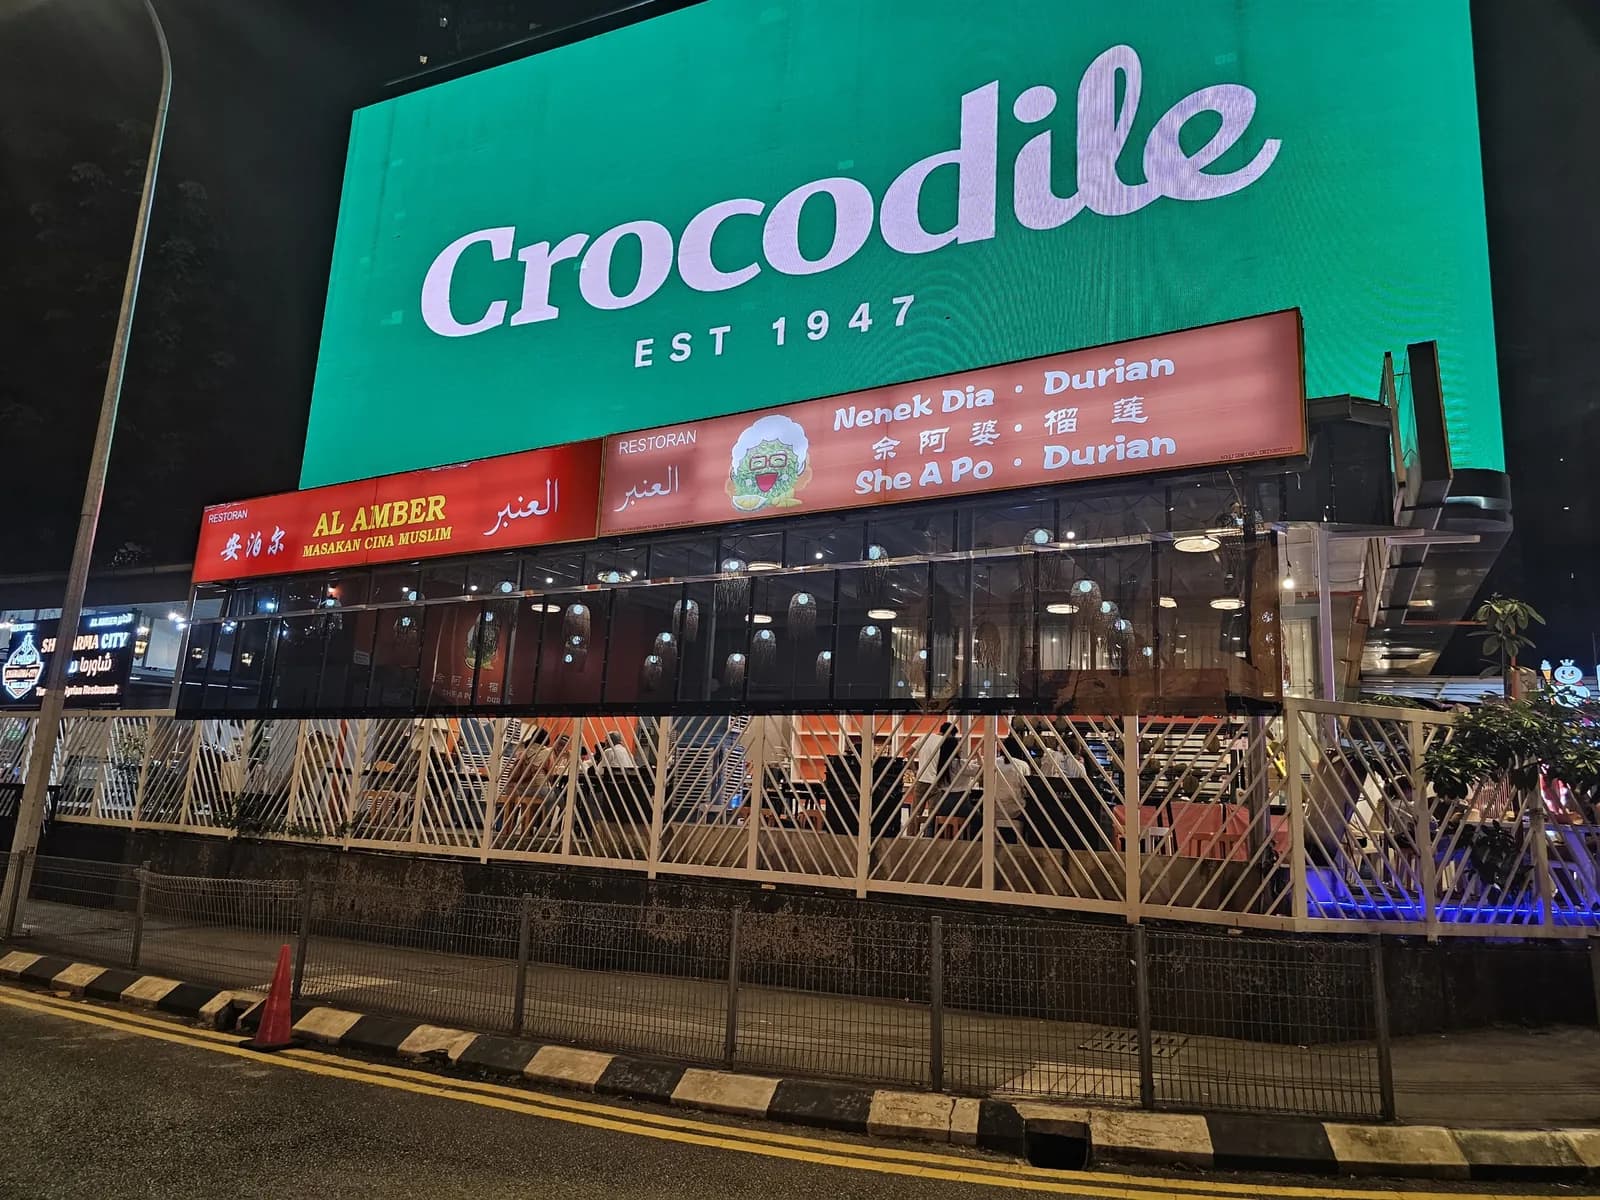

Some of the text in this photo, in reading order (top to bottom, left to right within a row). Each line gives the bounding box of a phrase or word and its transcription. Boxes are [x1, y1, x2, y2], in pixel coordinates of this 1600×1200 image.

[421, 44, 1281, 337] Crocodile
[635, 294, 915, 368] EST 1947
[833, 357, 1176, 432] Nenek Dia Durian
[618, 429, 697, 455] RESTORAN
[854, 434, 1177, 495] She A Po Durian
[482, 478, 560, 536] العنبر
[613, 465, 680, 513] العنبر
[208, 509, 248, 524] RESTORAN
[312, 494, 448, 538] AL AMBER
[302, 526, 452, 558] MASAKAN CINA MUSLIM
[101, 632, 129, 649] CITY
[82, 684, 118, 695] Restaurant
